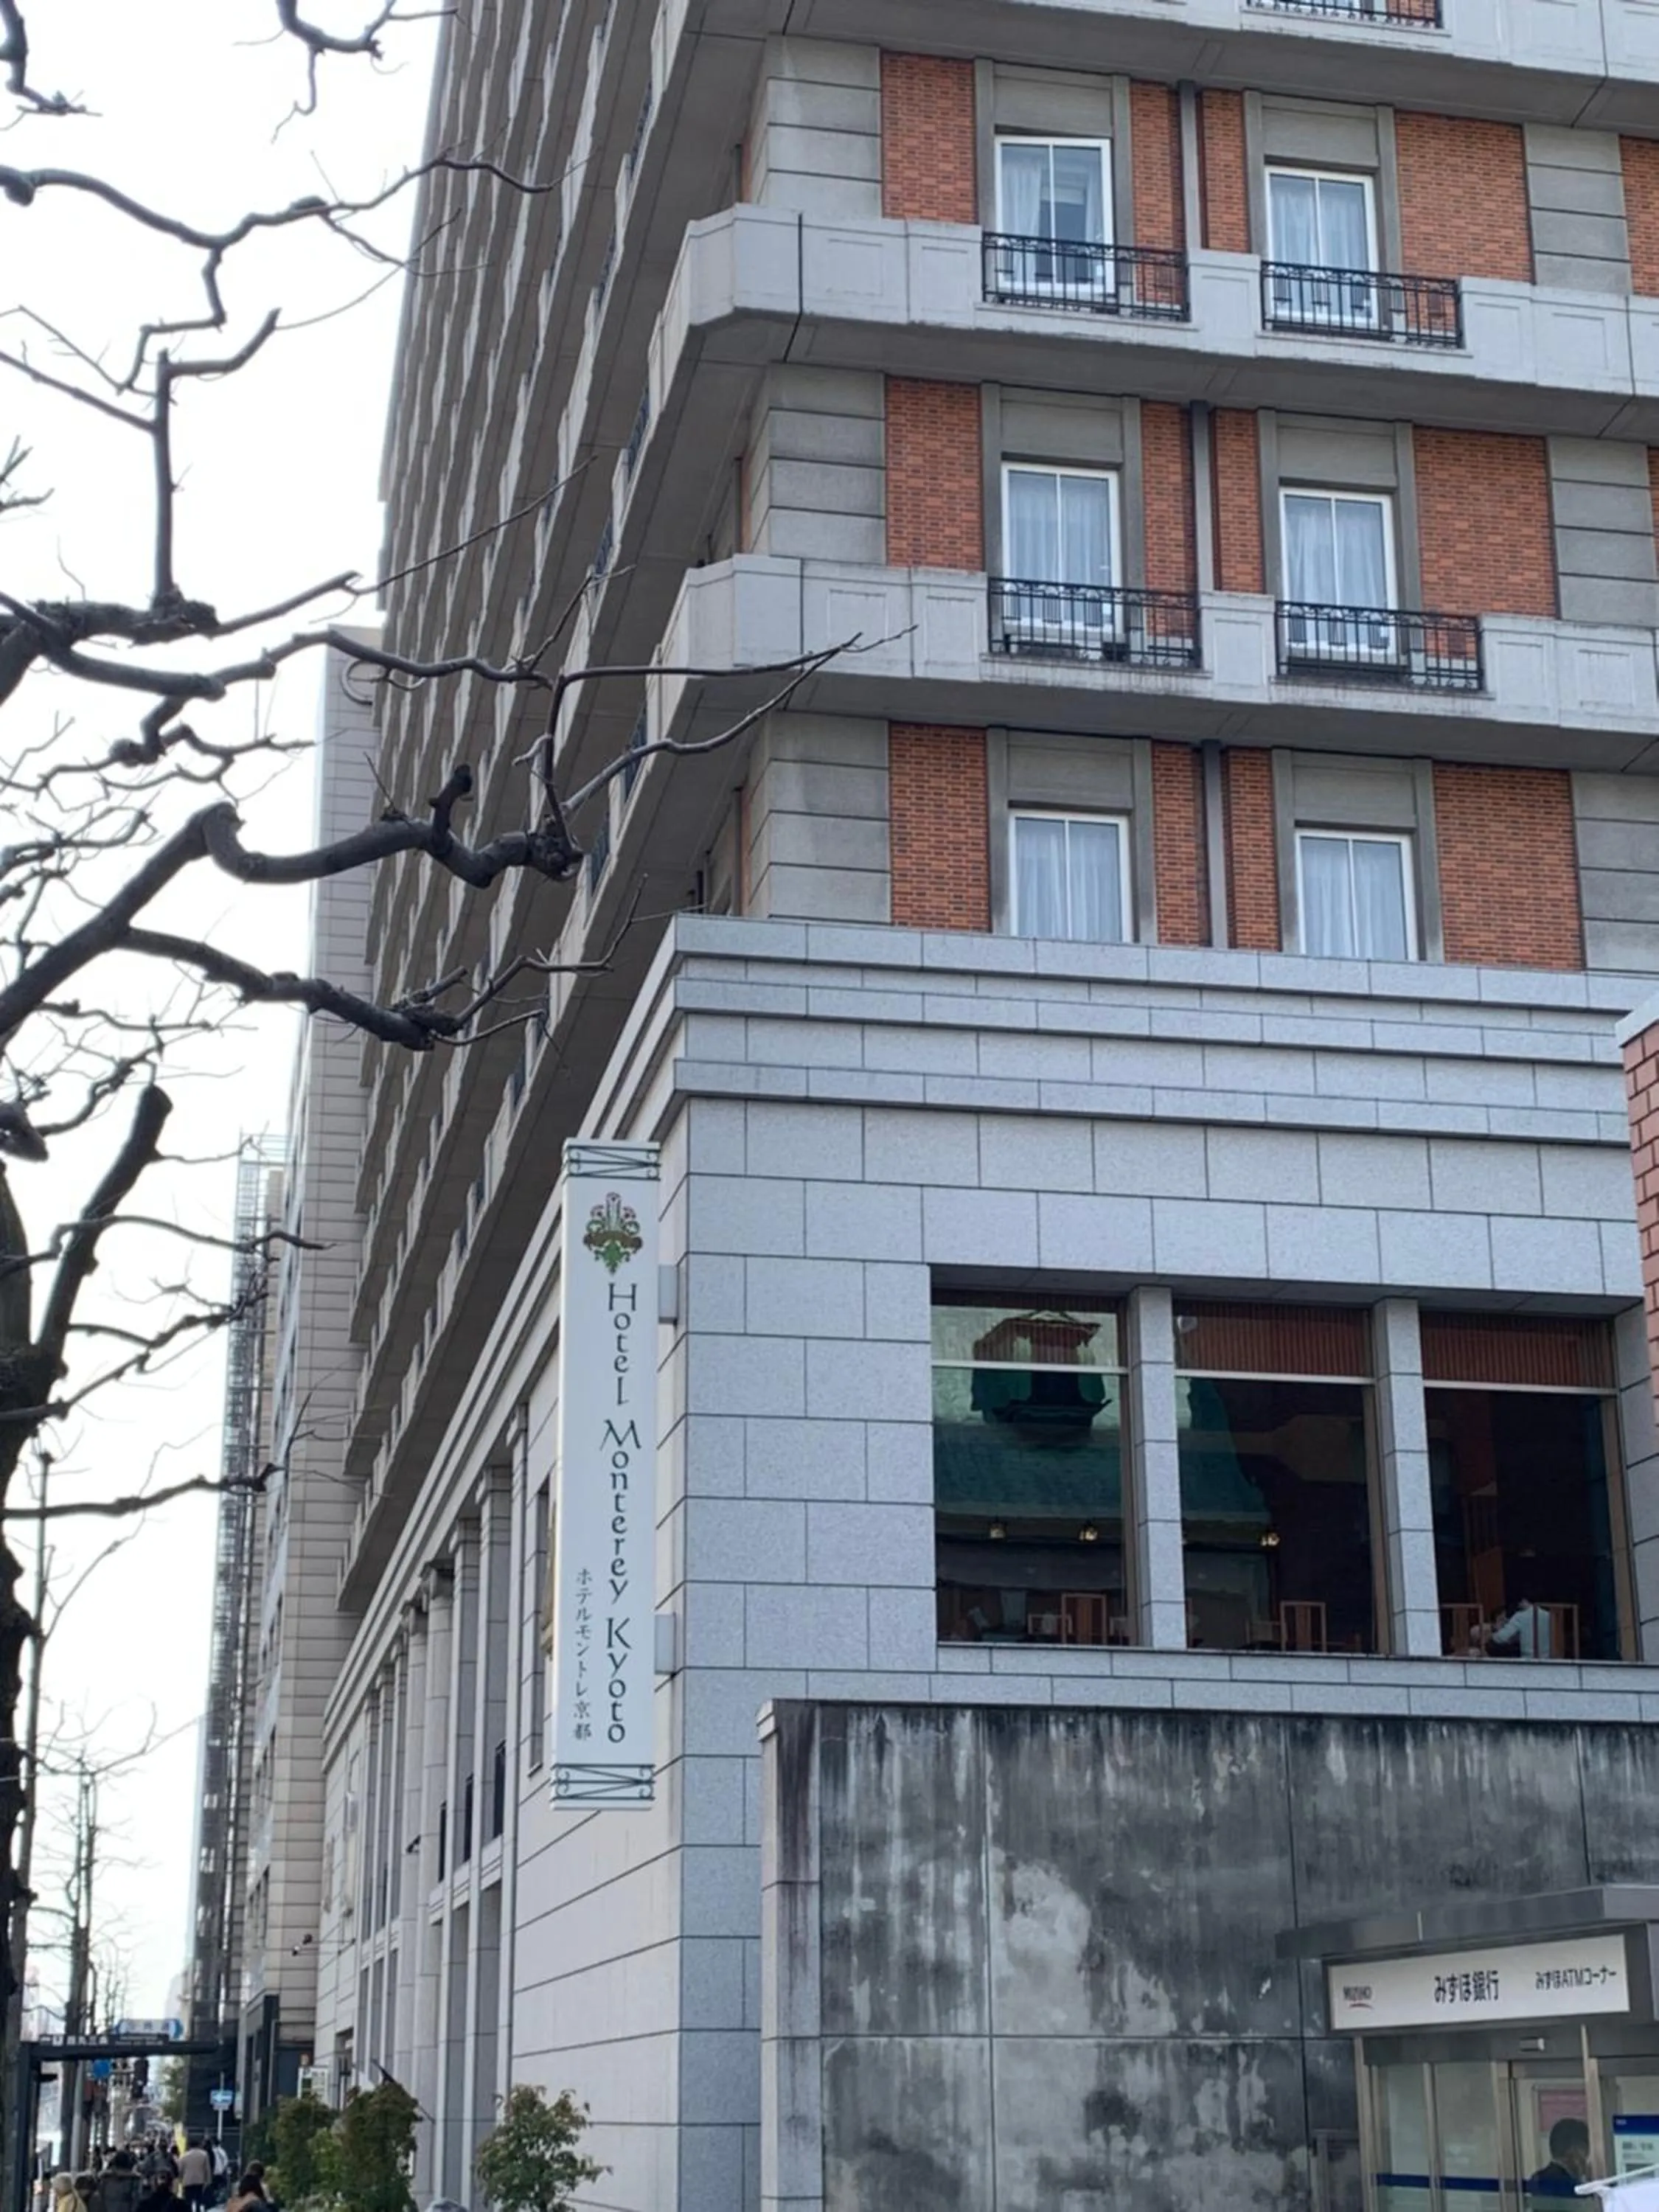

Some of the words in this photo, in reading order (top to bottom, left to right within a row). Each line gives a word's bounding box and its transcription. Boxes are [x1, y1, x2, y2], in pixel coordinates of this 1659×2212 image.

[608, 1283, 636, 1405] Hotel
[599, 1419, 641, 1604] Monterey
[573, 1568, 593, 1741] ホテルモントレ京都
[606, 1617, 632, 1744] Kyoto
[1433, 1969, 1500, 2004] みずほ銀行
[1535, 1964, 1617, 1991] みずほATMコーナー
